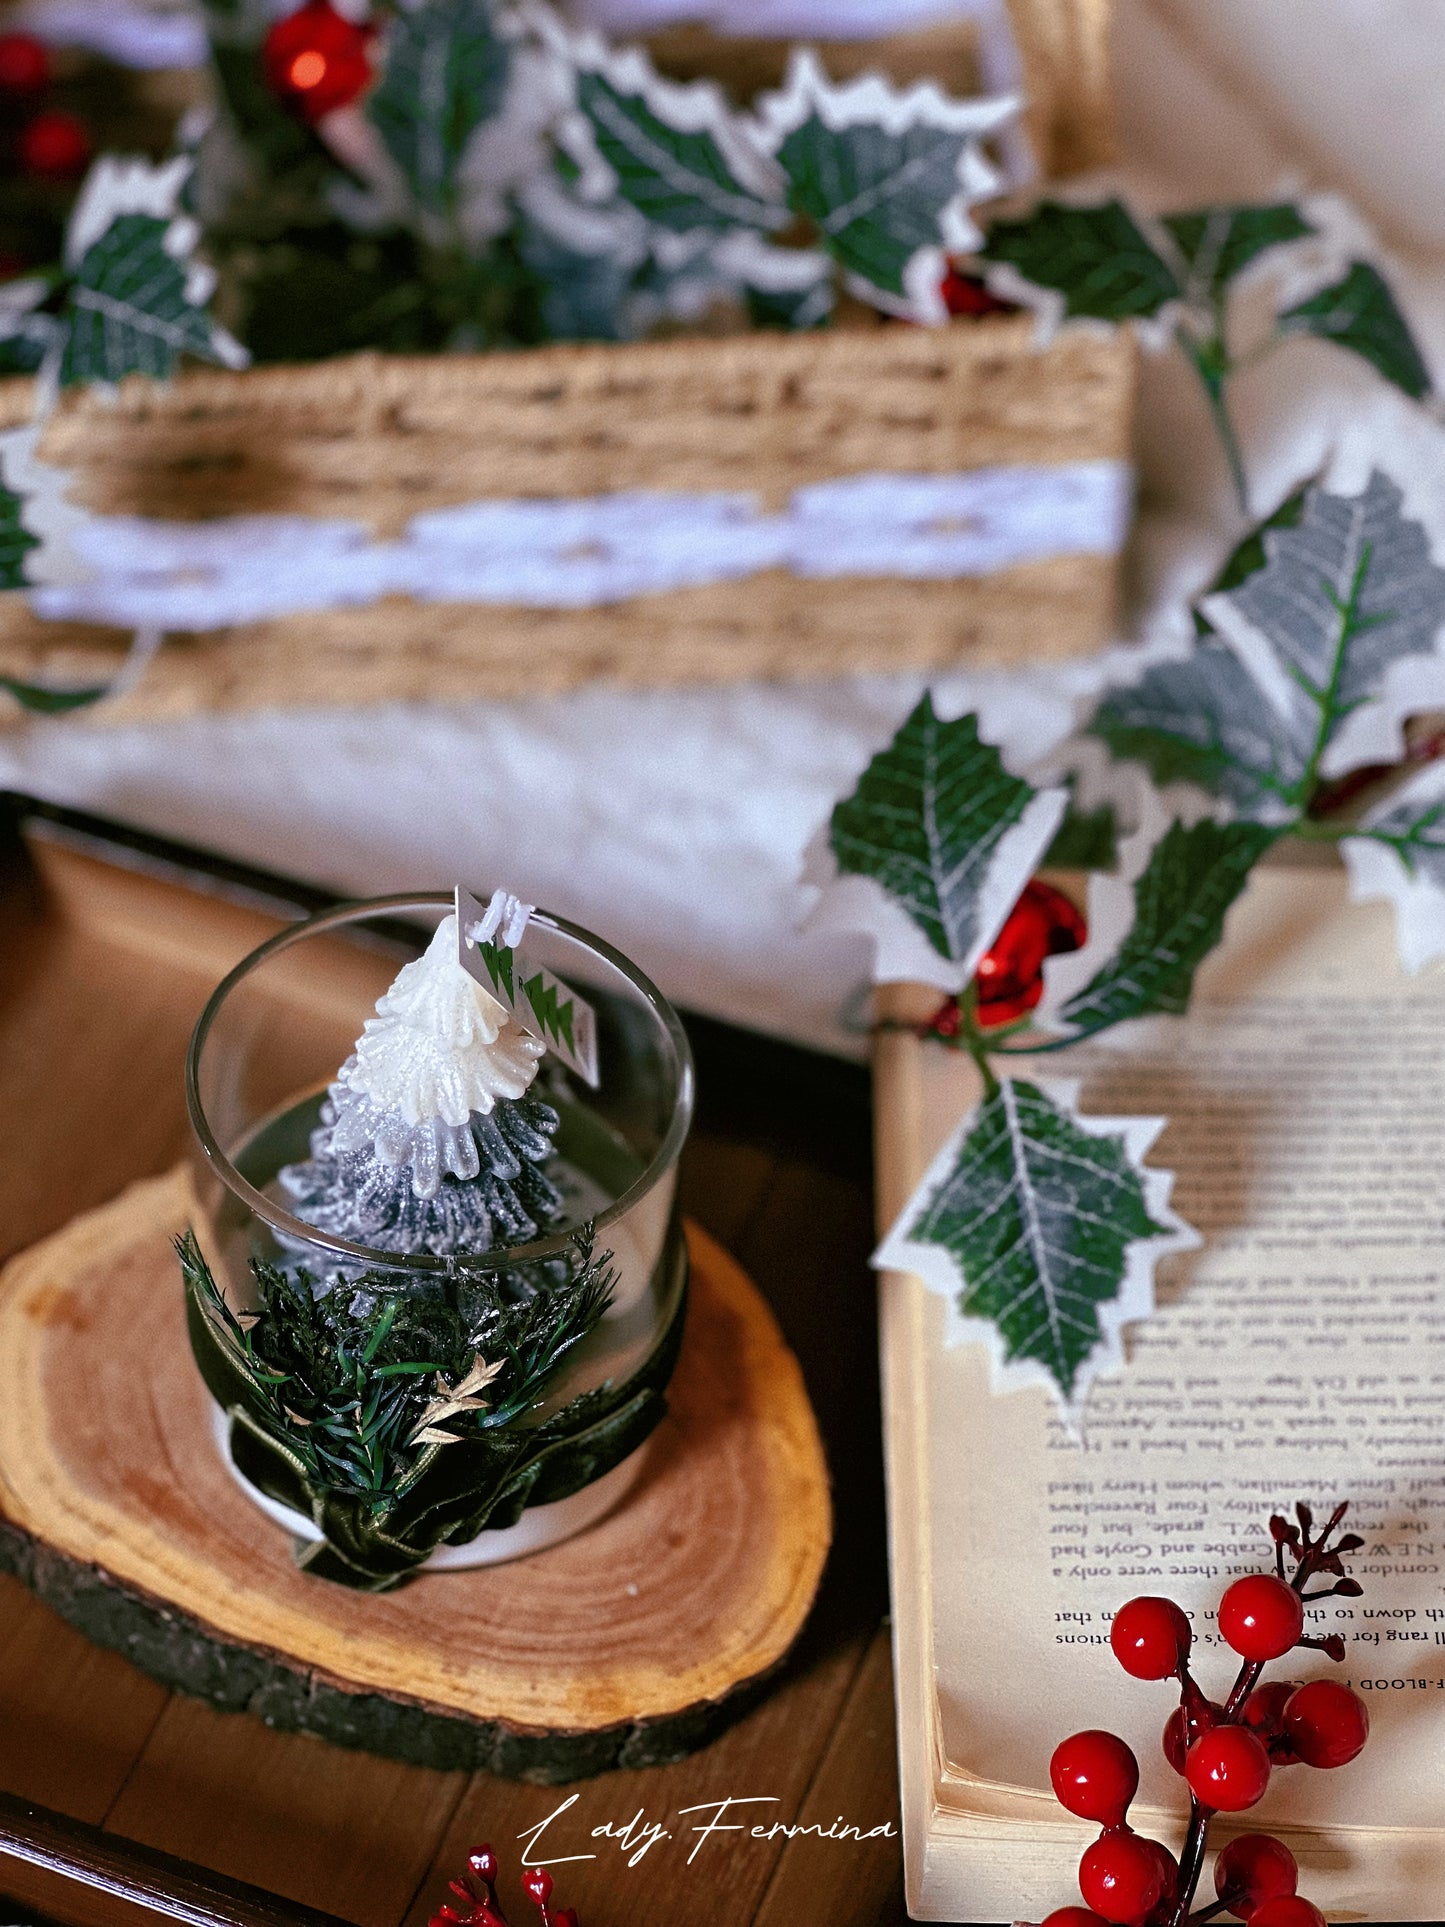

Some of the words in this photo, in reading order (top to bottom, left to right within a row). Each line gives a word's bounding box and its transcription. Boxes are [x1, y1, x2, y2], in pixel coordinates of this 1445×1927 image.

[1047, 1481, 1093, 1496] liked
[1101, 1479, 1157, 1495] Harry
[1165, 1480, 1224, 1494] whom
[1049, 1502, 1156, 1517] Ravenclaws
[1165, 1502, 1208, 1516] Four
[1049, 1525, 1088, 1538] four
[1102, 1524, 1132, 1536] but
[1307, 1520, 1384, 1531] requied
[1399, 1522, 1427, 1534] the
[1050, 1546, 1085, 1559] had
[1094, 1542, 1152, 1558] Goyle
[1160, 1544, 1195, 1556] and
[1203, 1544, 1272, 1556] Crabbe
[1052, 1568, 1062, 1576] a
[1068, 1566, 1111, 1580] only
[1118, 1566, 1163, 1576] were
[1169, 1566, 1217, 1578] there
[1361, 1565, 1438, 1578] corridor
[1054, 1612, 1091, 1625] that
[1335, 1609, 1354, 1619] to
[1363, 1609, 1416, 1623] down
[1055, 1634, 1111, 1646] otions
[1317, 1632, 1345, 1641] te
[1353, 1633, 1380, 1646] for
[1386, 1630, 1428, 1642] rang
